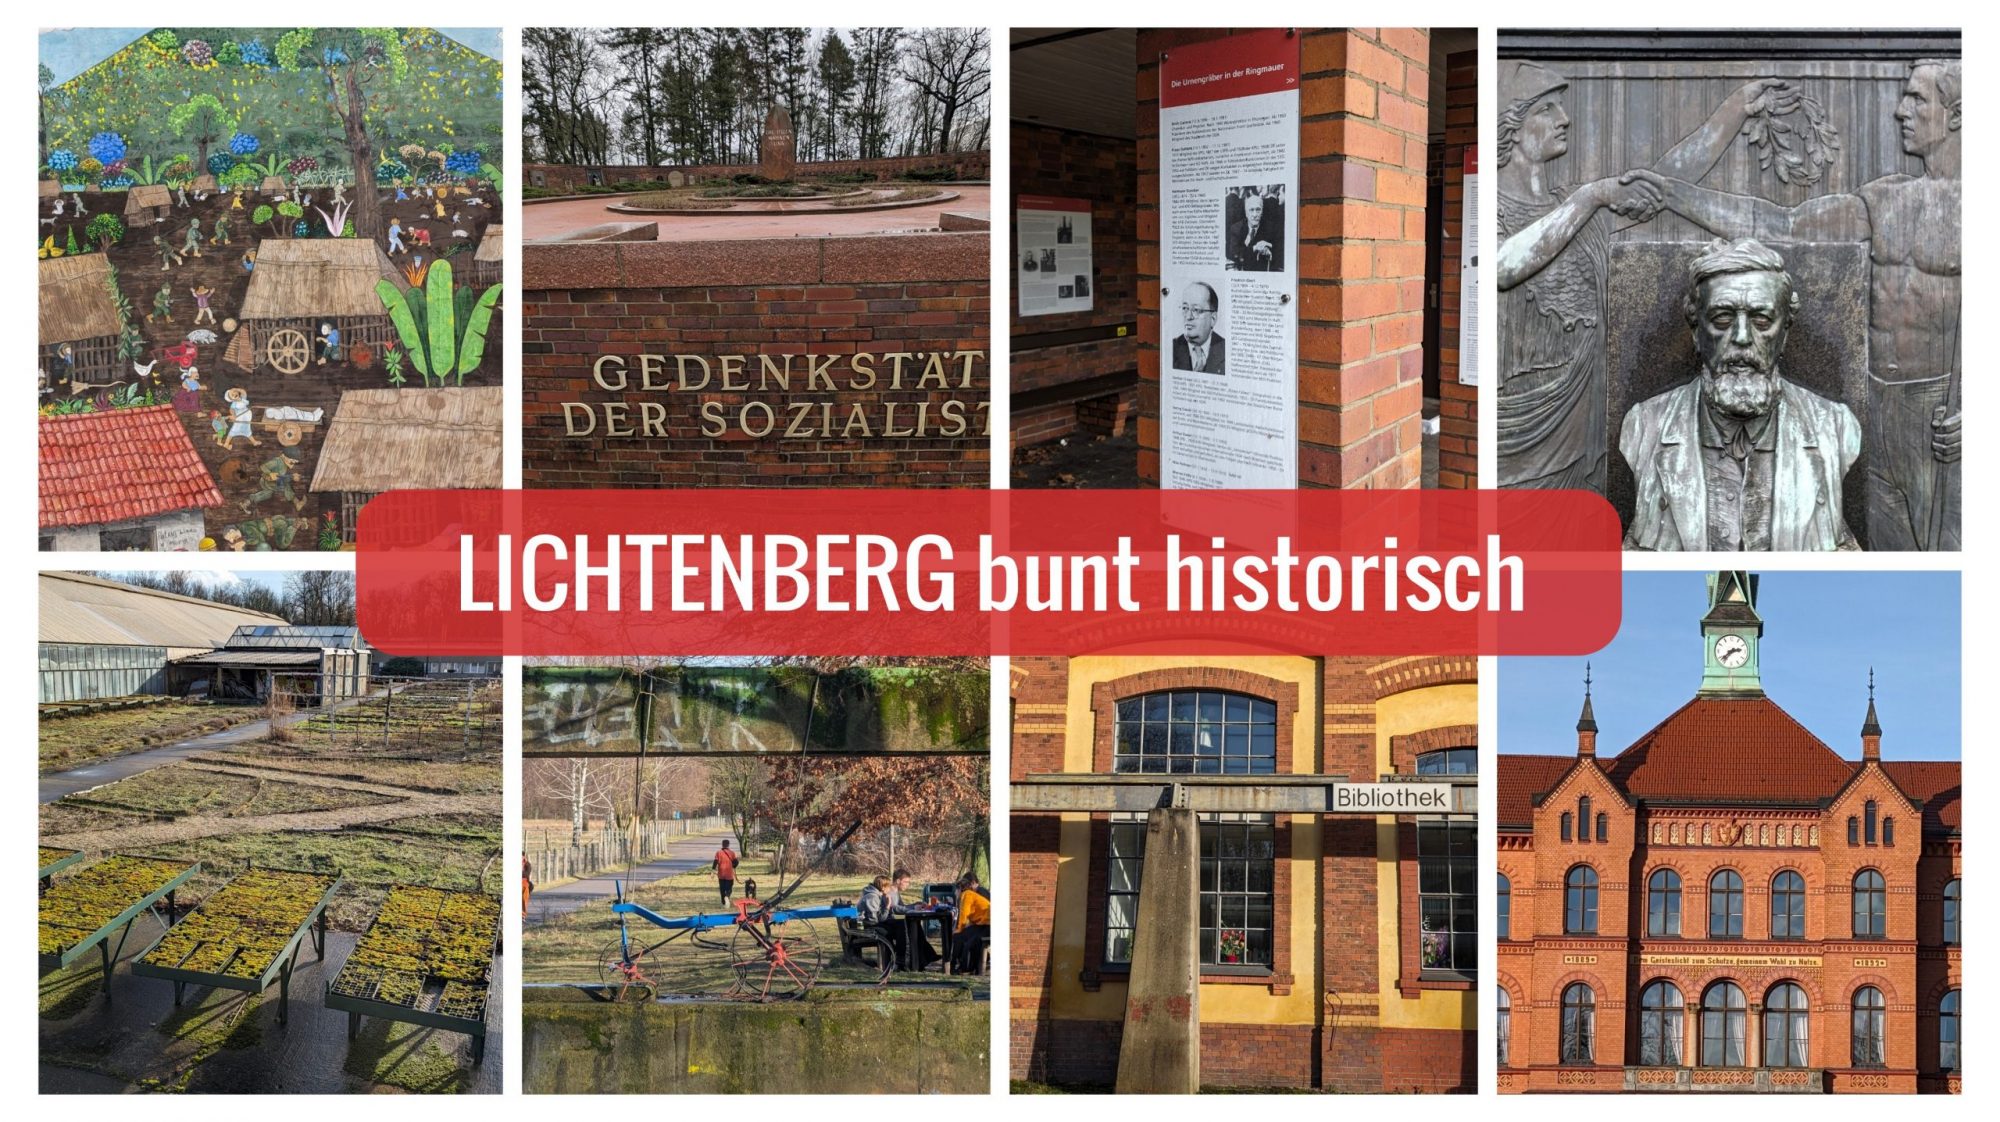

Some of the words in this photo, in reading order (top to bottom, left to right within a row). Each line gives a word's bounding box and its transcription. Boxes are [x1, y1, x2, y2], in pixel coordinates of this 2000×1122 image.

[1171, 79, 1181, 88] Die
[1183, 73, 1223, 84] Urnengräber
[1224, 71, 1231, 79] in
[1232, 69, 1244, 78] der
[1245, 63, 1284, 76] Ringmauer
[593, 350, 985, 391] GEDENKSTÄT
[560, 402, 668, 438] DER
[1338, 787, 1446, 807] Bibliothek
